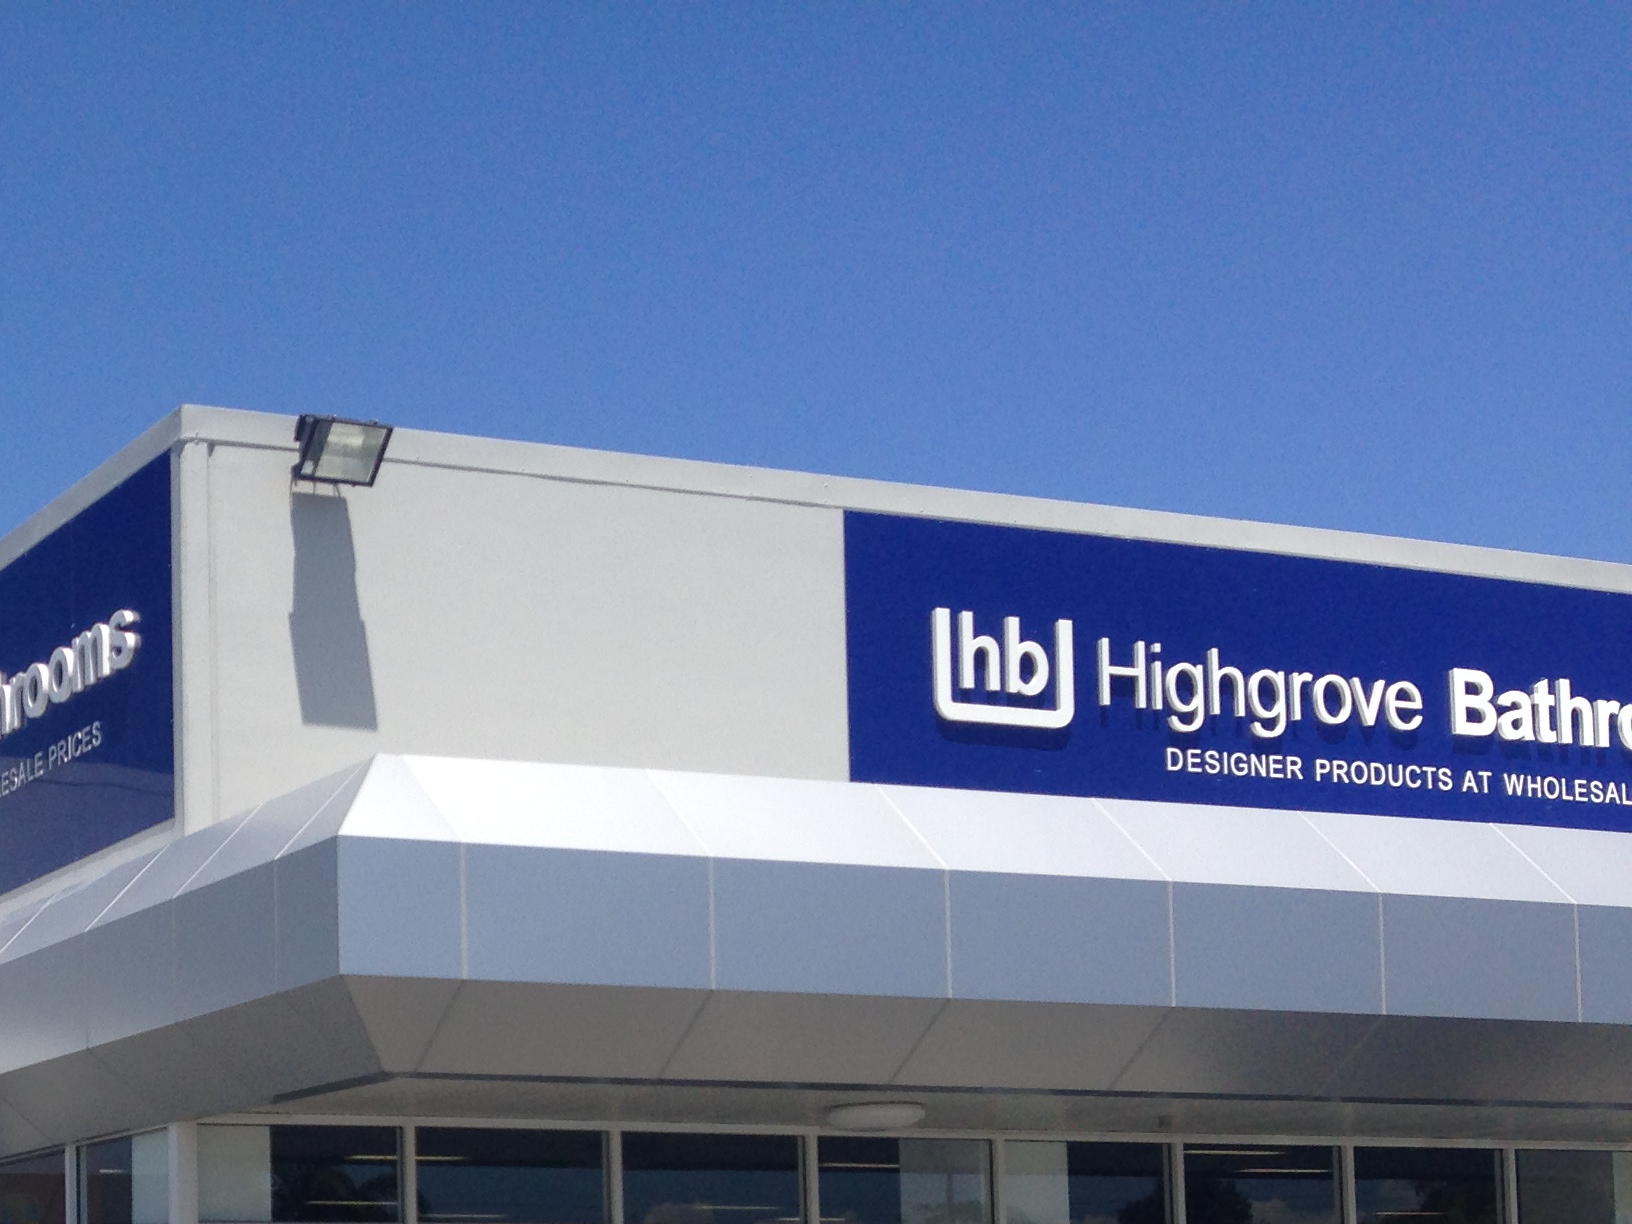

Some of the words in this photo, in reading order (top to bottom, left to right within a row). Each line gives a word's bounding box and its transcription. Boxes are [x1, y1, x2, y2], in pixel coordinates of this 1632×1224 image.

[1097, 637, 1424, 740] Highgrove
[48, 720, 103, 770] PRICES
[1166, 747, 1303, 780] DESIGNER
[1315, 758, 1453, 792] PRODUCTS
[1461, 770, 1492, 794] AT
